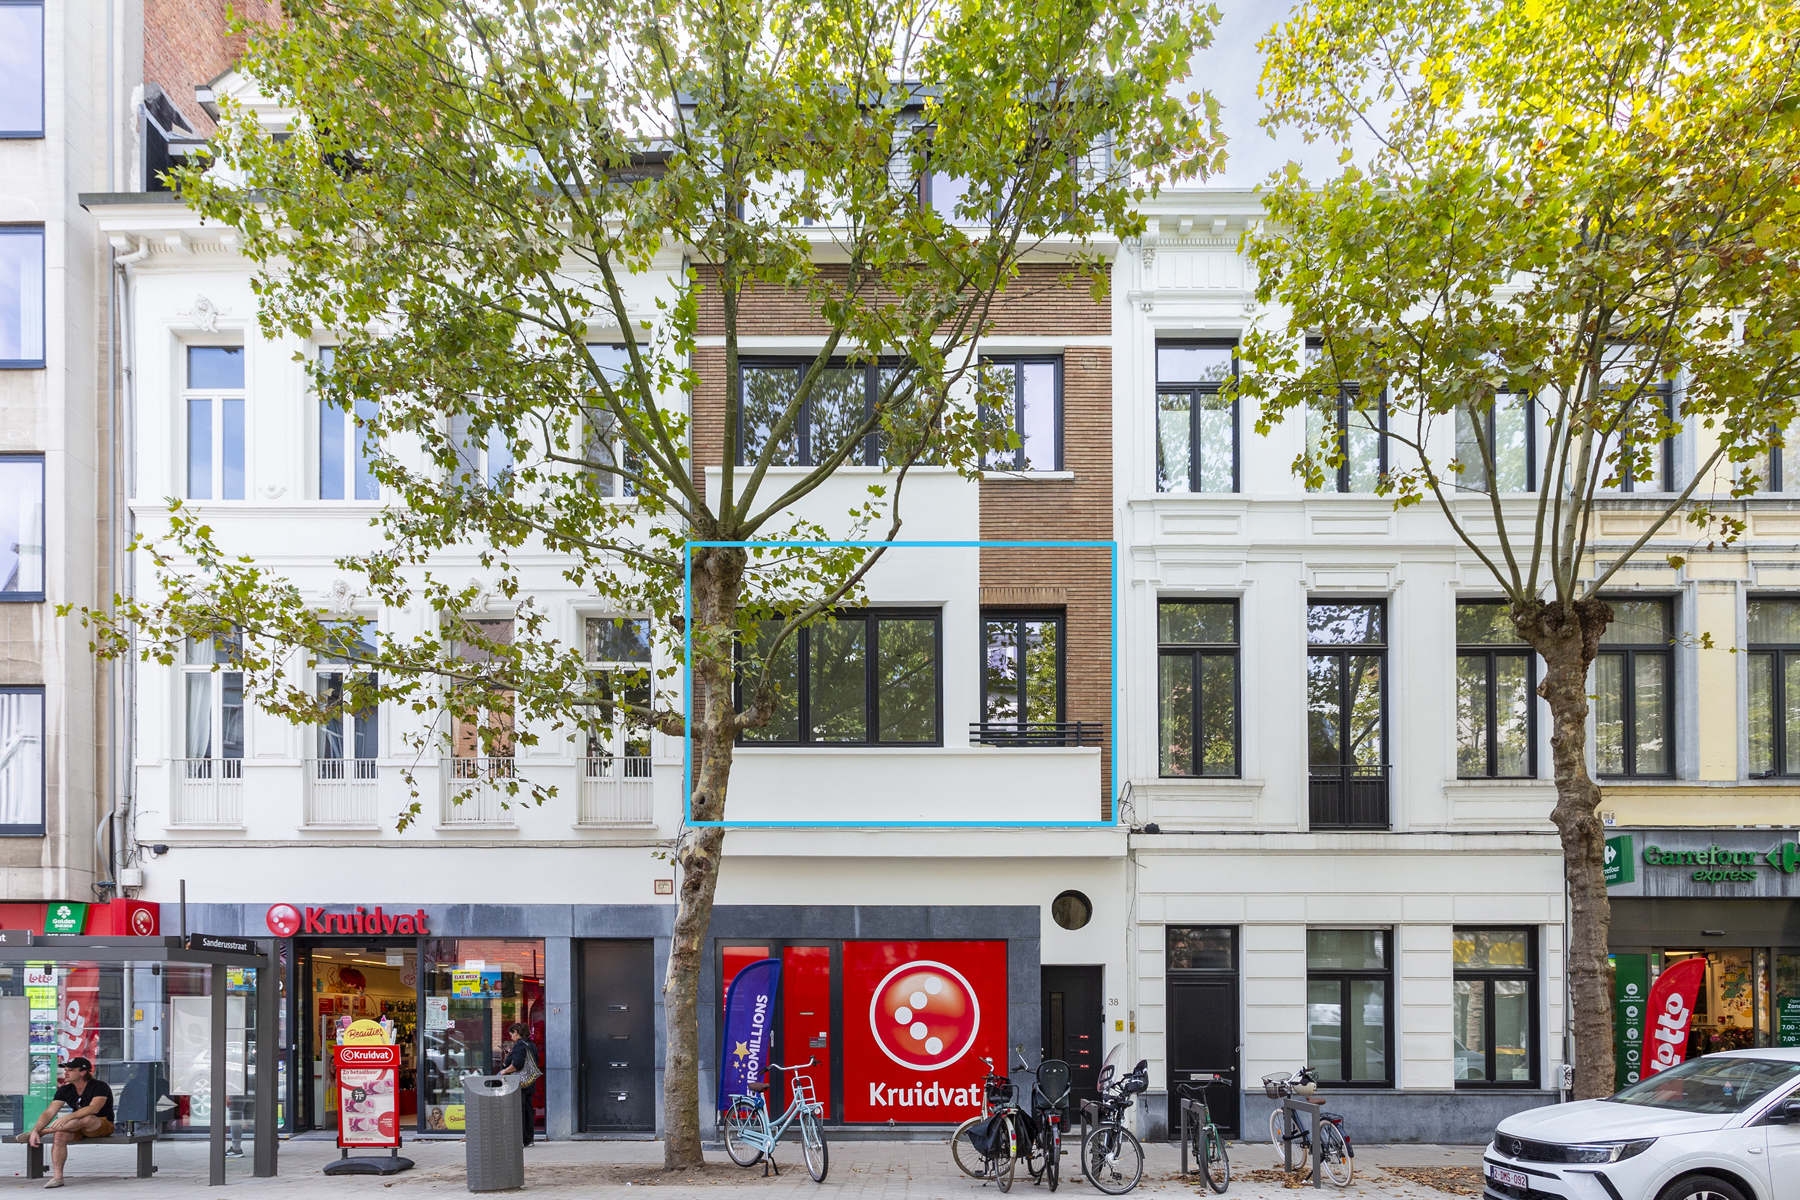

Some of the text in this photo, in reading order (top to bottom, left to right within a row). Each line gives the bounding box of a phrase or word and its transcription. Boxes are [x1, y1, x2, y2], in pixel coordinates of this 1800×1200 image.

[1644, 845, 1758, 865] Carrefour
[1693, 869, 1757, 884] express
[305, 906, 430, 935] Kruidvat
[203, 938, 247, 951] Sanderusstraat
[1109, 998, 1119, 1006] 38
[347, 1028, 384, 1040] Beauties
[747, 995, 768, 1098] EROMILLIONS
[354, 1051, 389, 1059] Kruidvat
[869, 1081, 981, 1107] Kruidvat
